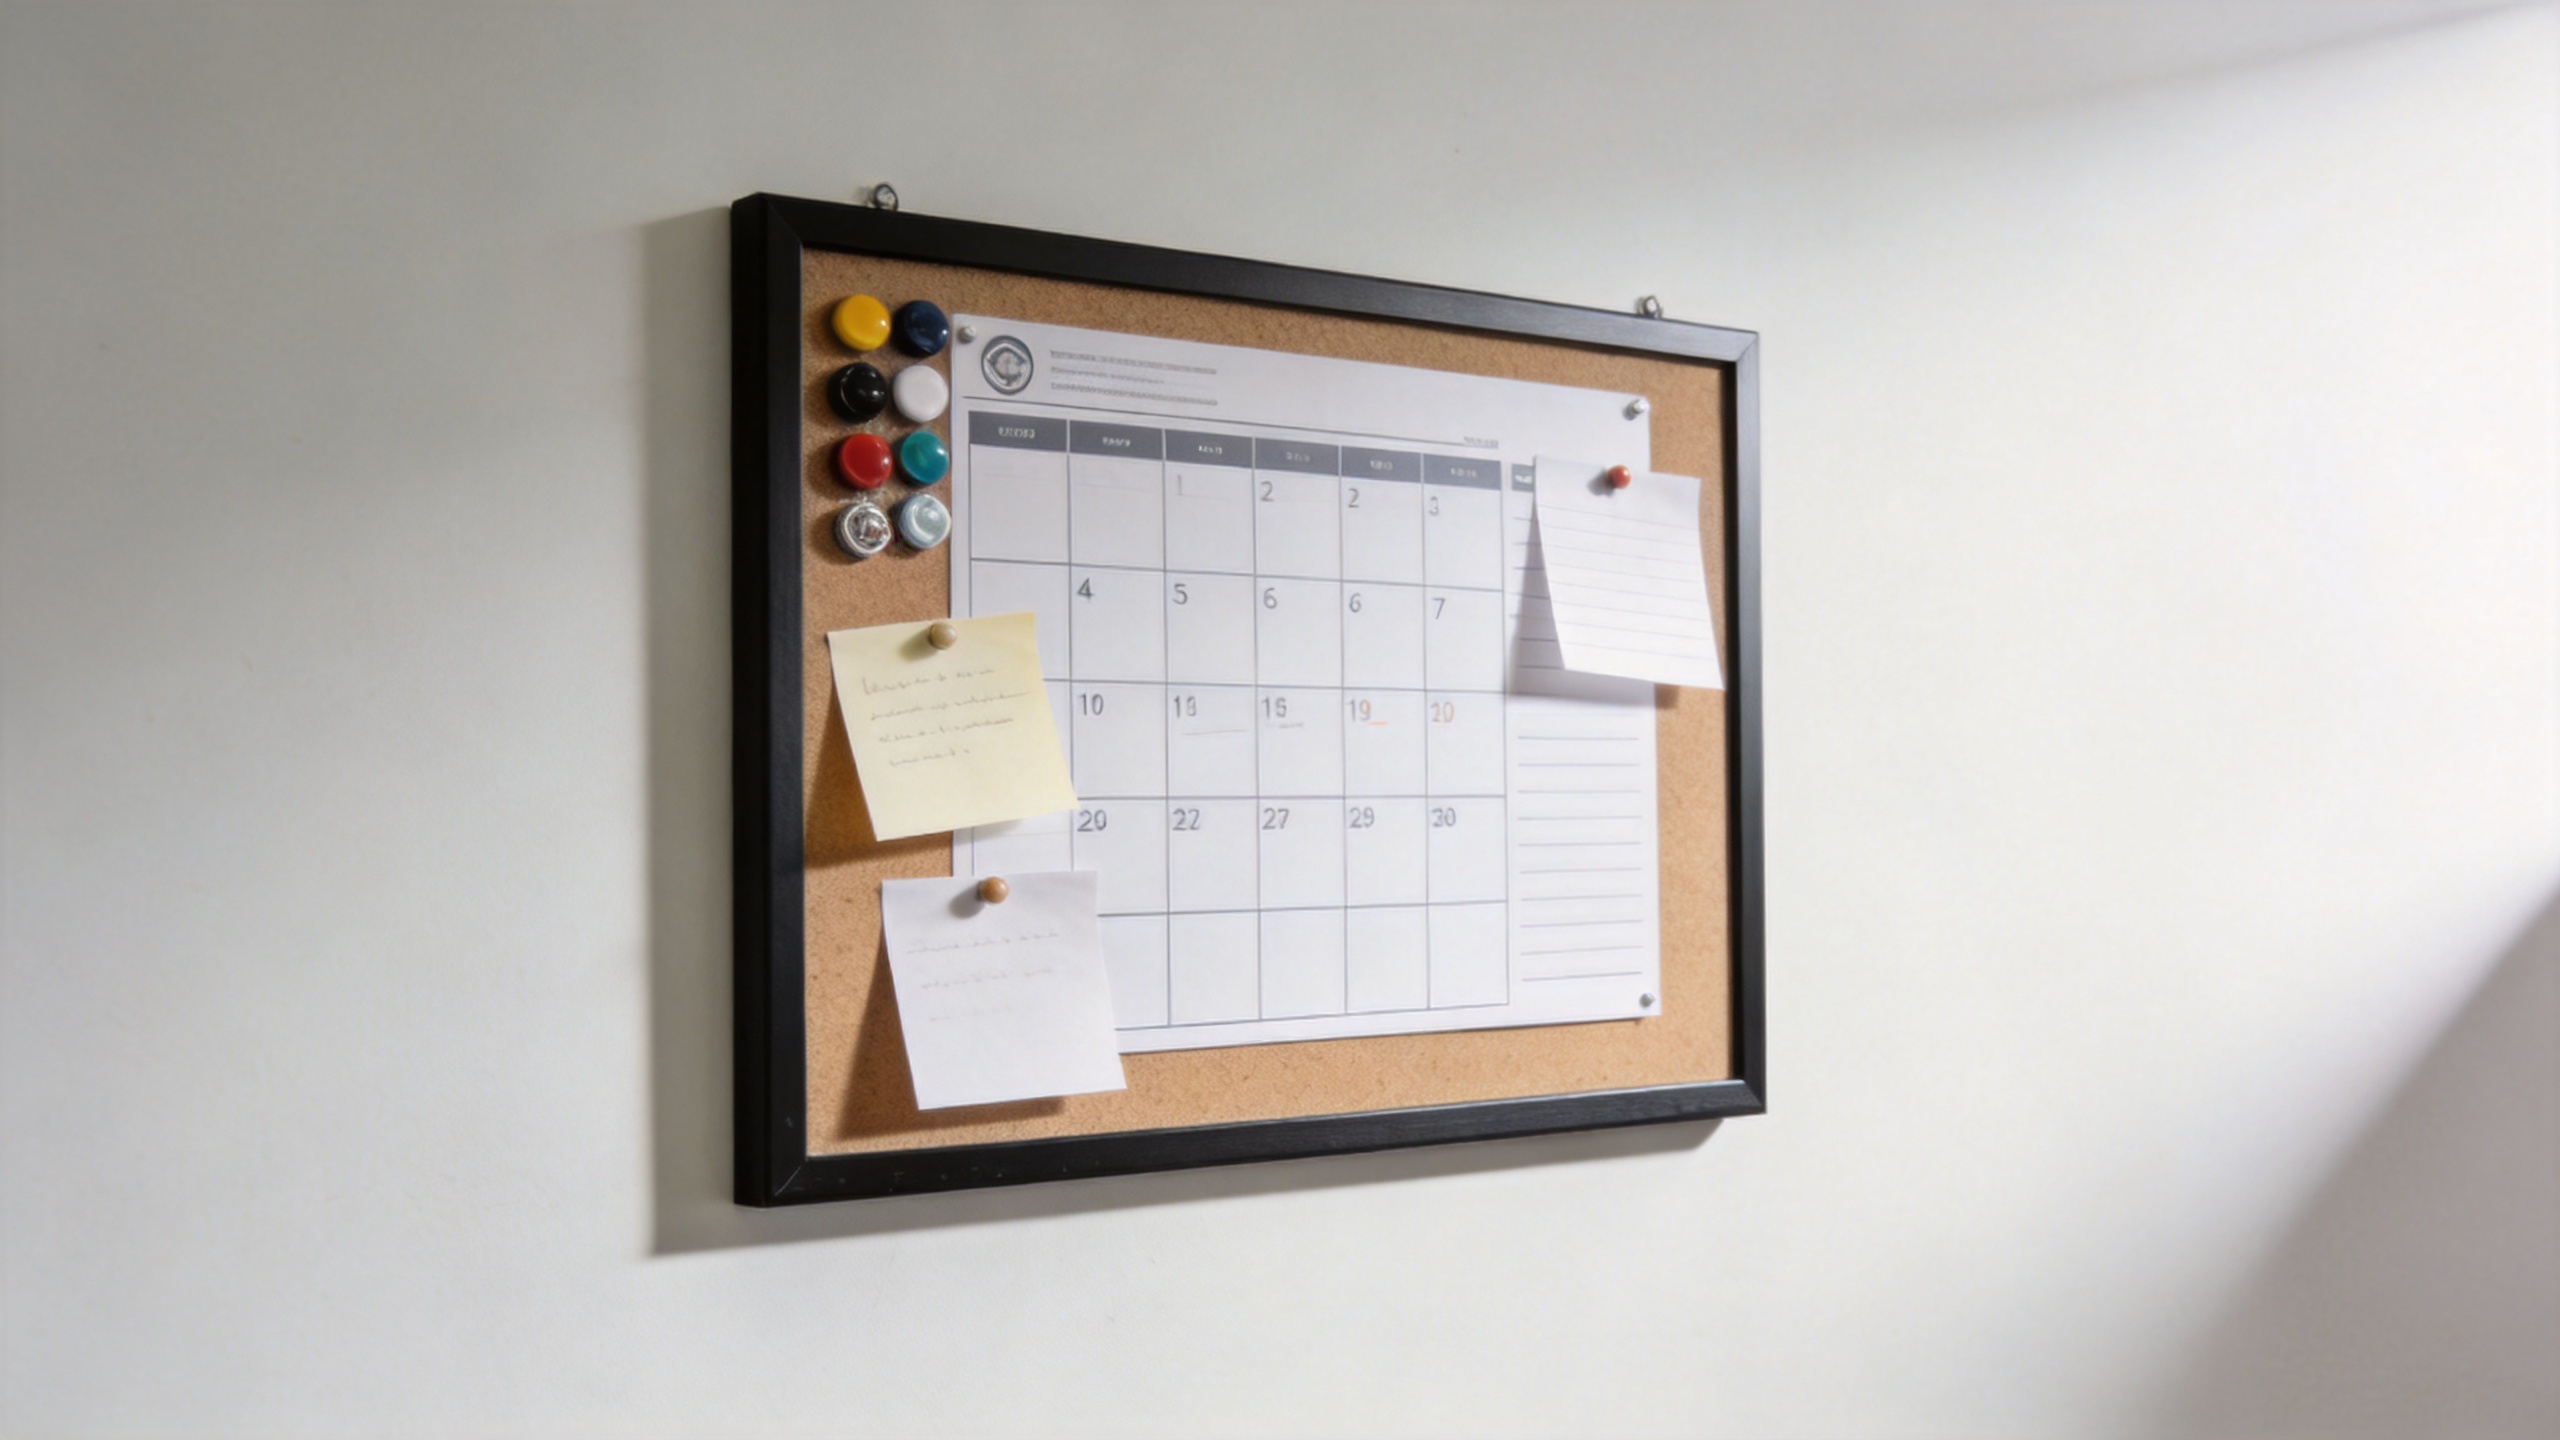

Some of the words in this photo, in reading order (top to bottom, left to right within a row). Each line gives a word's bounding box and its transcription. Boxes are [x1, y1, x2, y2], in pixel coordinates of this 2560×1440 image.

[1260, 480, 1276, 503] 2
[1347, 487, 1360, 509] 2
[1076, 577, 1095, 601] 4
[1172, 582, 1189, 606] 5
[1262, 586, 1278, 610] 6
[1348, 592, 1362, 614] 6
[1432, 597, 1447, 620] 7
[1079, 693, 1104, 716] 10
[1076, 809, 1108, 833] 20
[1172, 807, 1200, 832] 22
[1261, 807, 1290, 831] 27
[1348, 806, 1375, 829] 29
